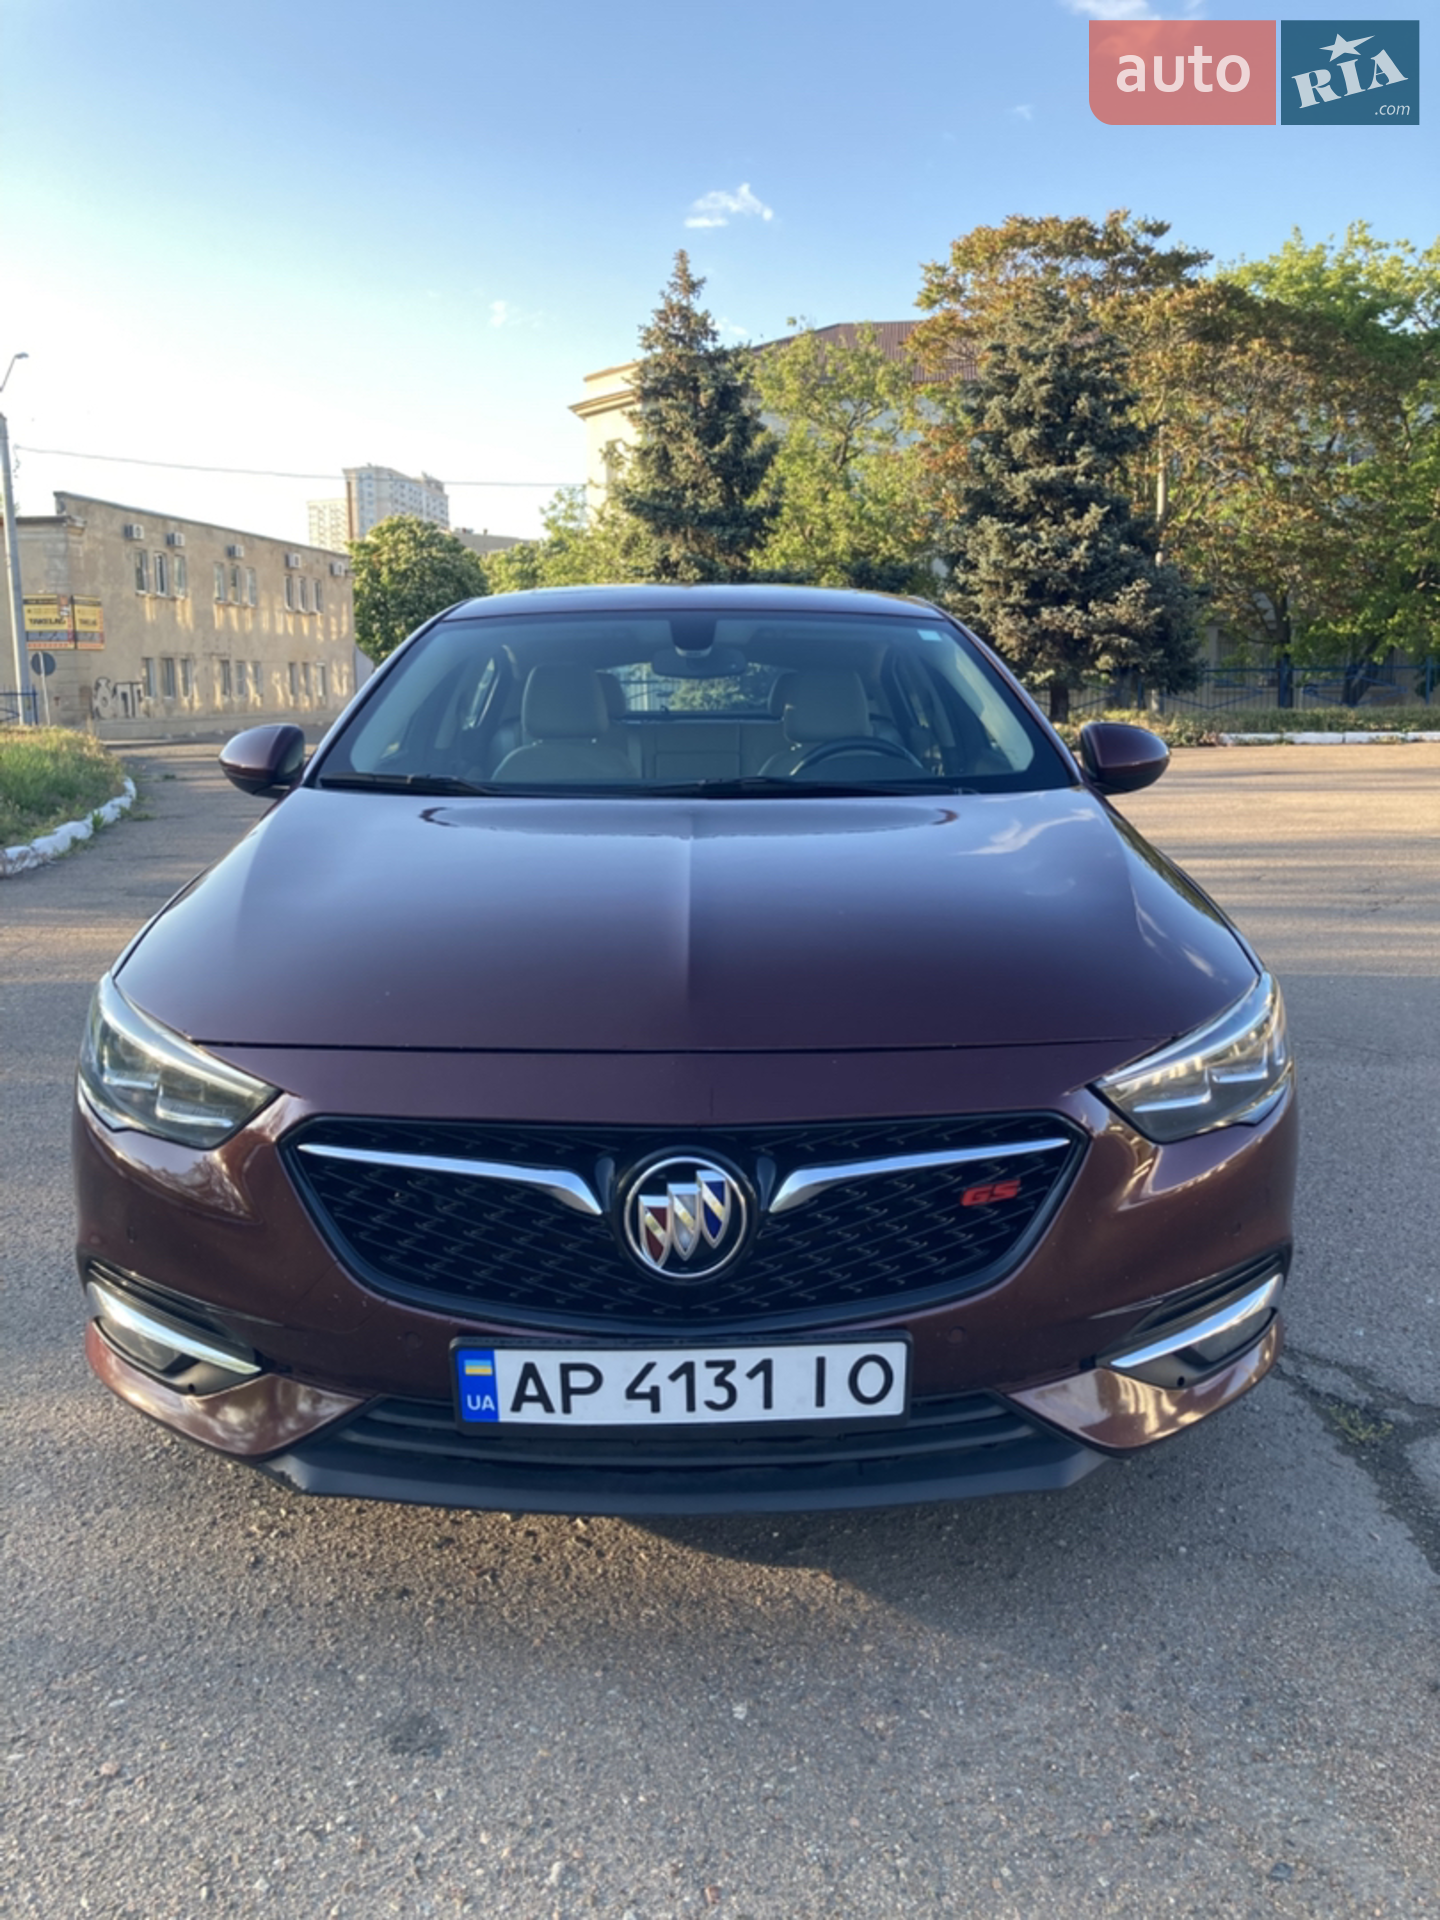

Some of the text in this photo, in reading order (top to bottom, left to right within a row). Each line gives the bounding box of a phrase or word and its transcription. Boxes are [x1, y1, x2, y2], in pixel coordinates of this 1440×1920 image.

[962, 1180, 1021, 1206] GS
[510, 1354, 895, 1414] AP 4131 IO
[466, 1394, 496, 1412] UA
